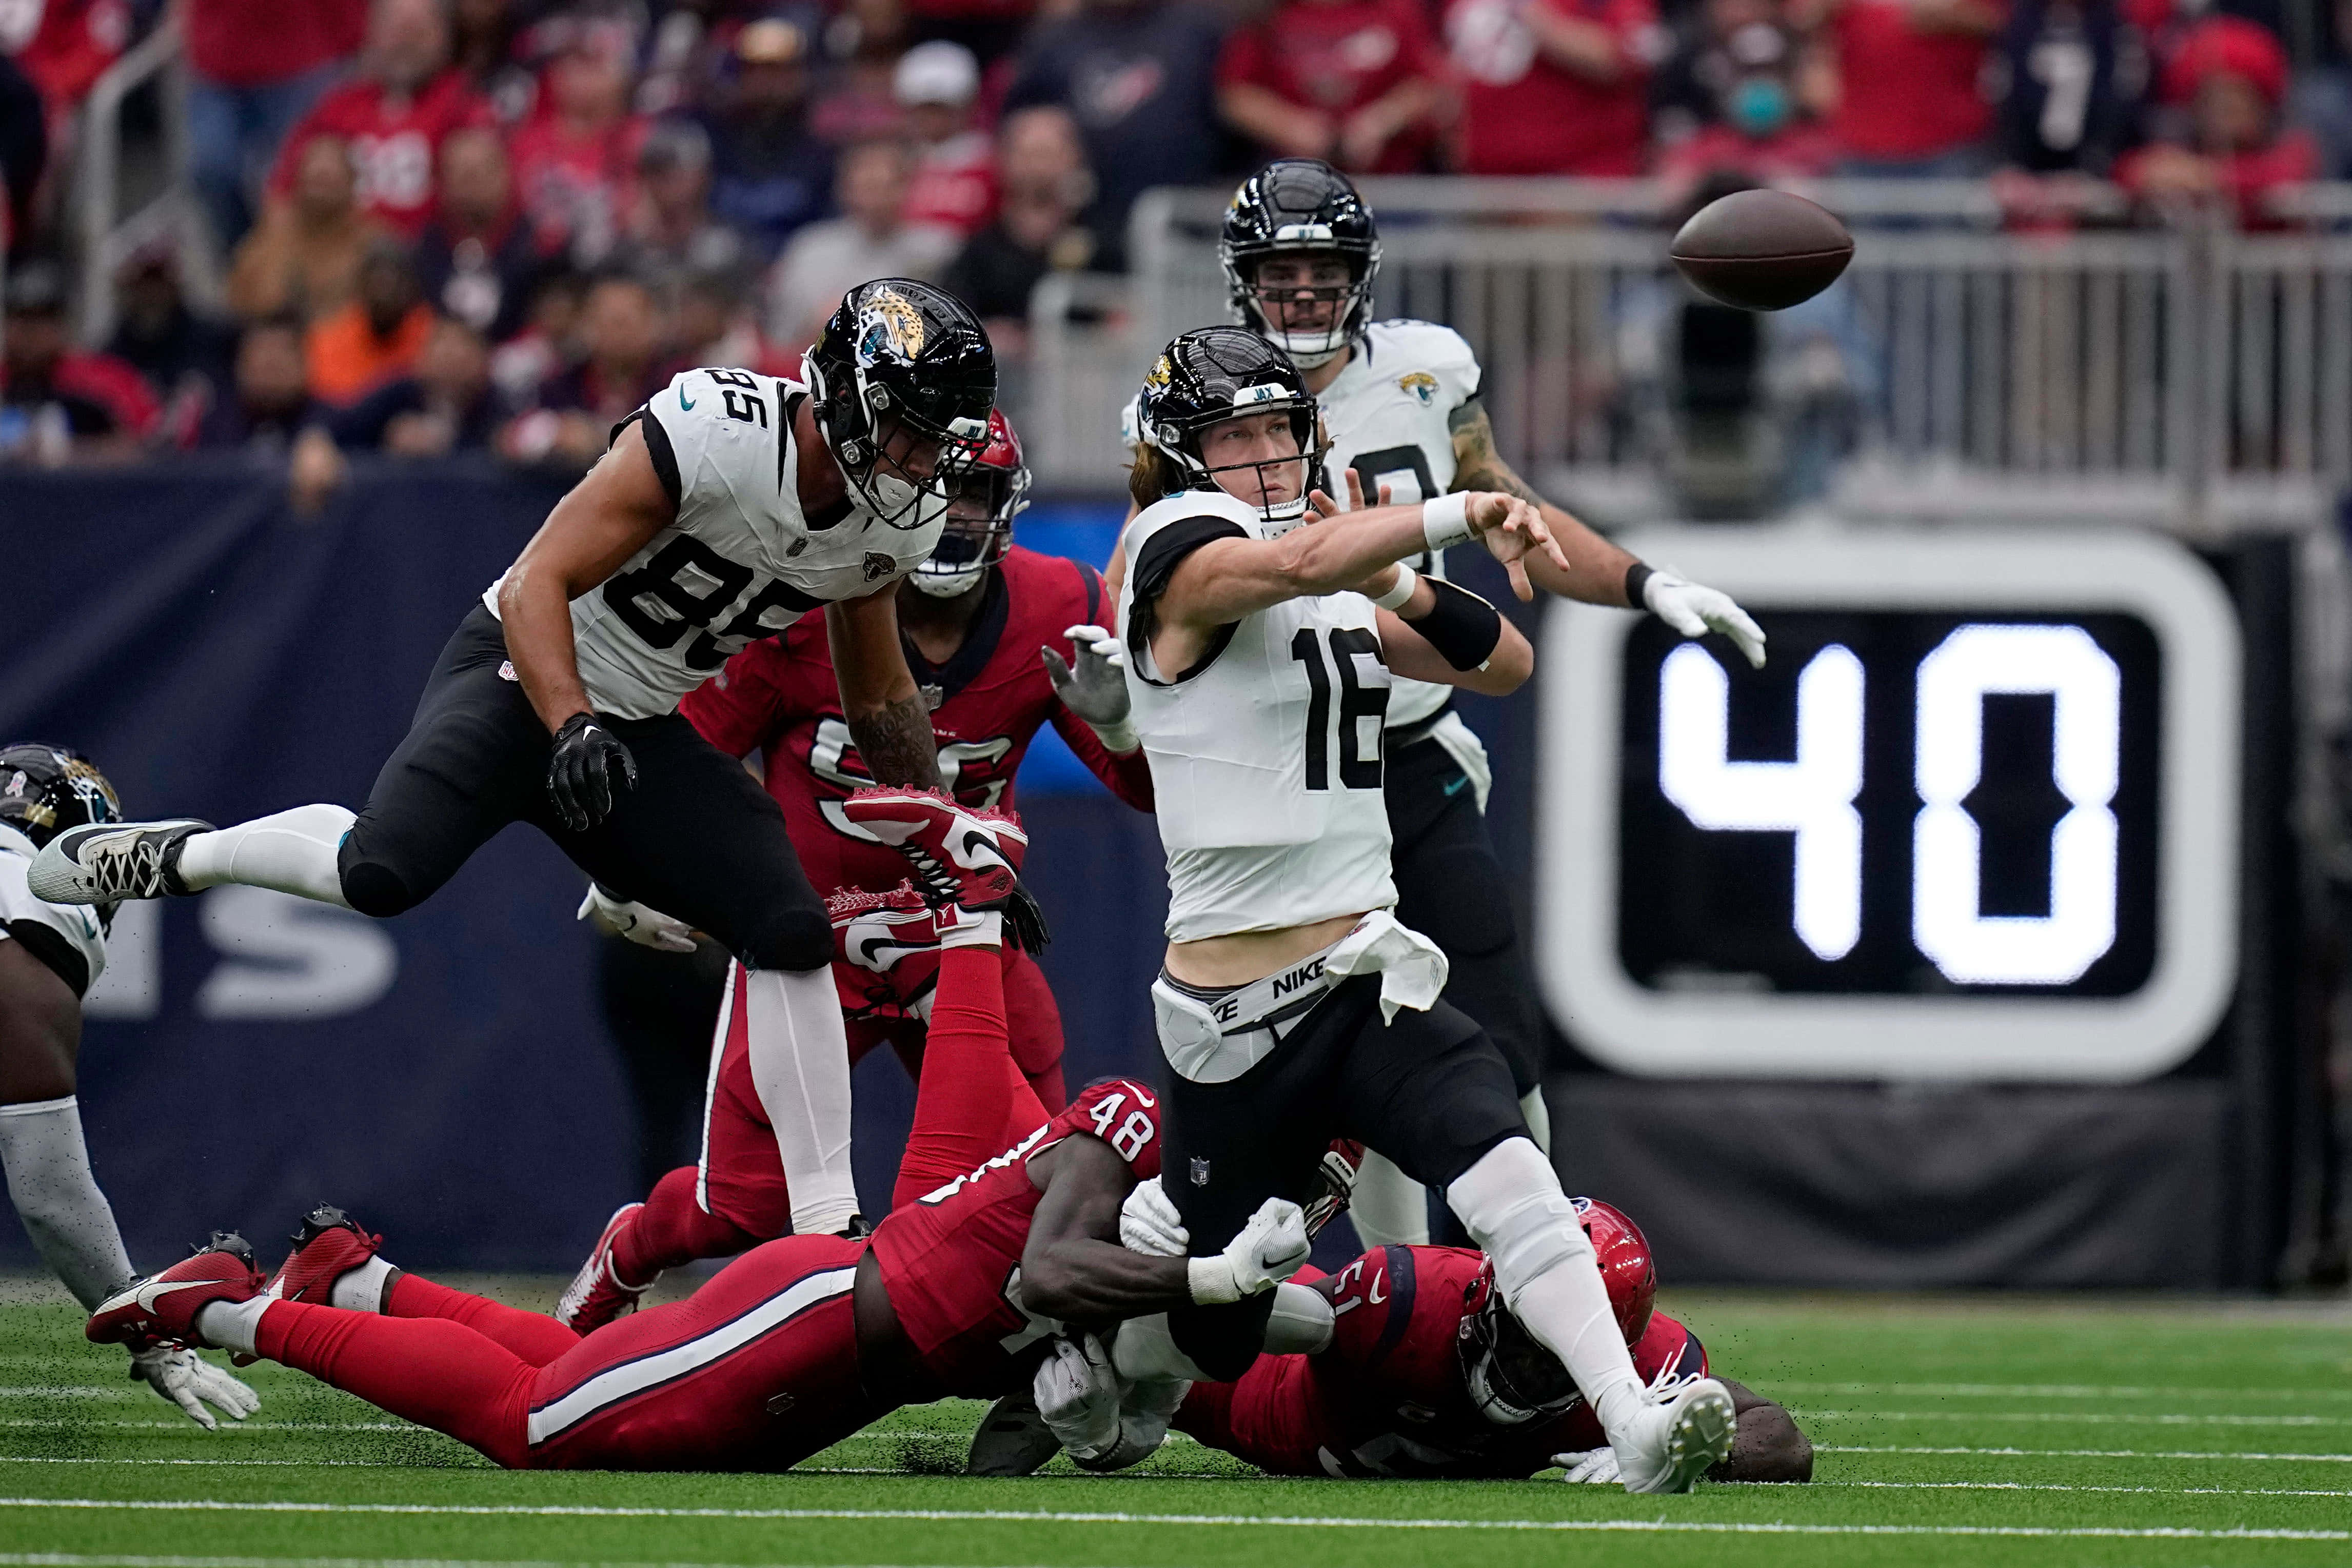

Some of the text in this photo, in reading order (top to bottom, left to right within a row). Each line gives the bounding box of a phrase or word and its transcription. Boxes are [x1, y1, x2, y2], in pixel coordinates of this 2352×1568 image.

[704, 369, 768, 429] 85
[1254, 386, 1274, 401] JAX
[602, 533, 836, 671] 85
[1292, 627, 1391, 790] 16
[1659, 623, 2121, 985] 40
[1273, 956, 1327, 1000] NIKE
[1210, 999, 1238, 1024] KE
[1089, 1092, 1155, 1162] 48
